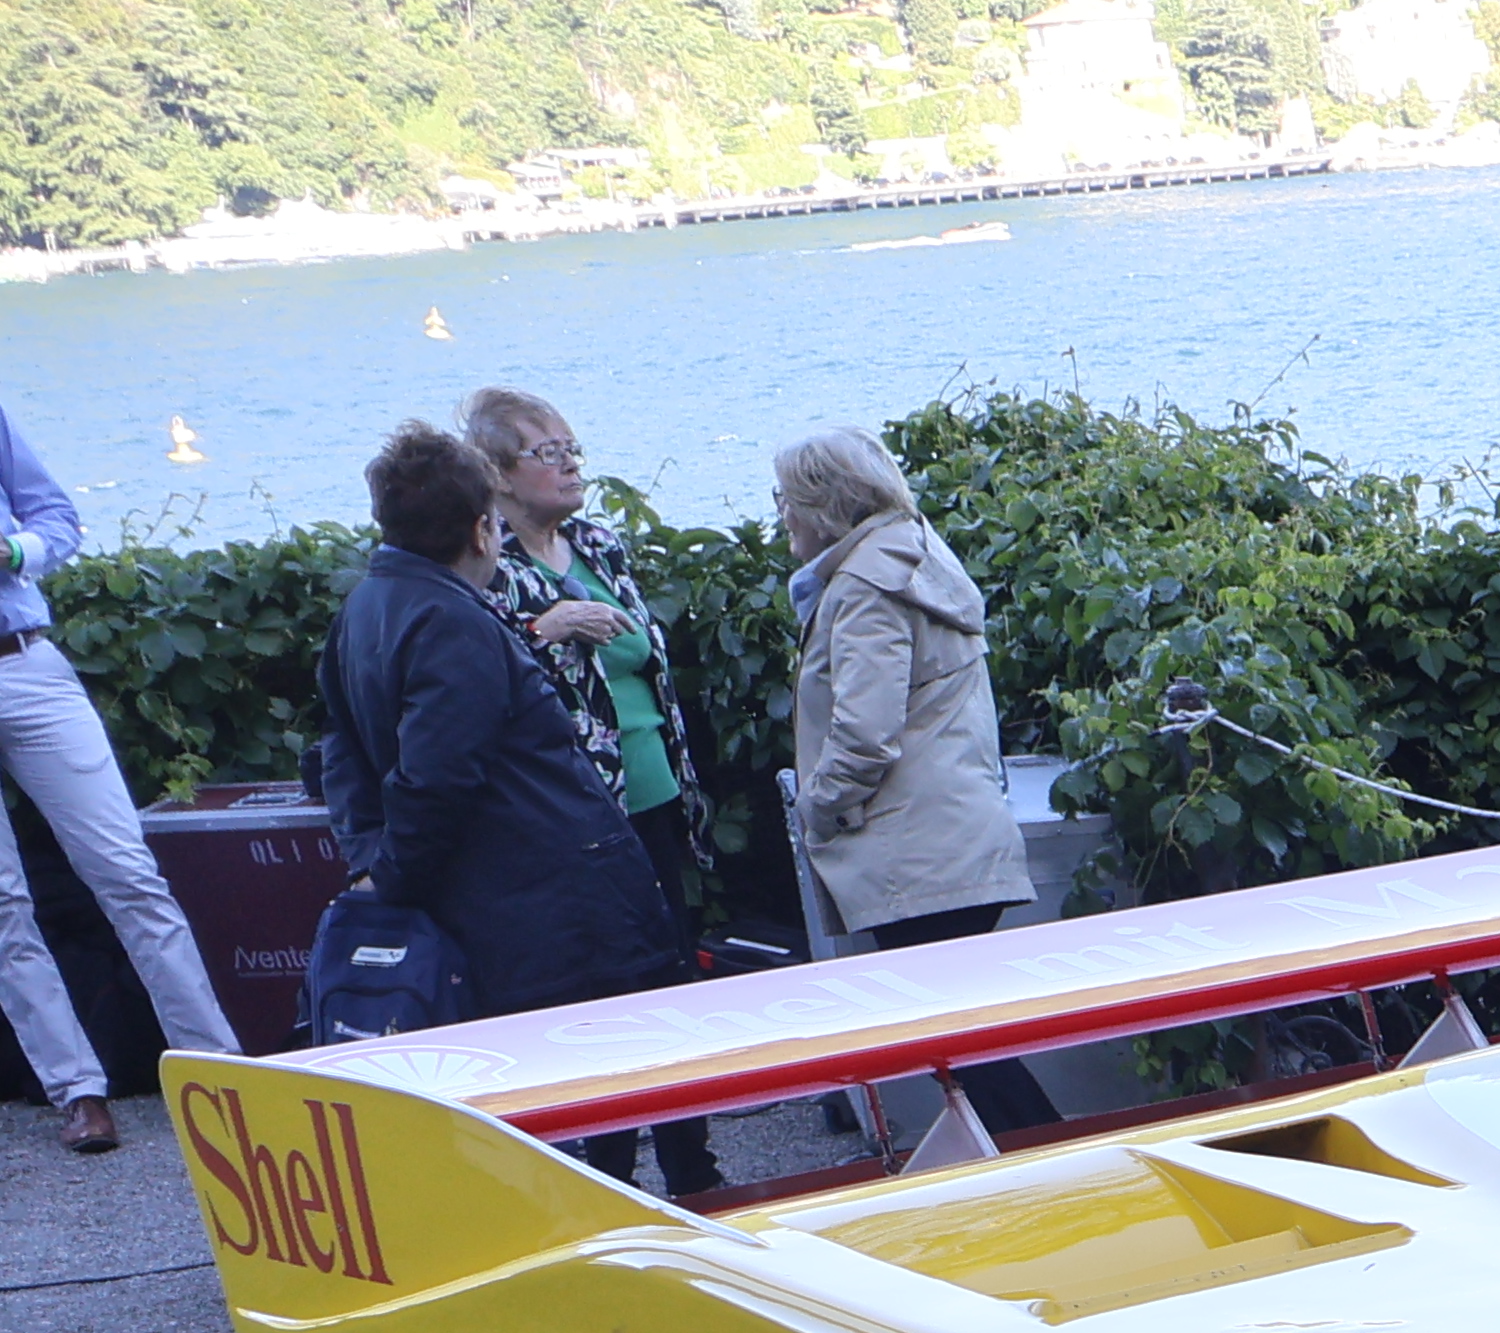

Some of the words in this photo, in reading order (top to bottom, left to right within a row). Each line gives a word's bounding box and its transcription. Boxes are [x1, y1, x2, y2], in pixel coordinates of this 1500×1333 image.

[546, 969, 954, 1062] Shell
[1001, 919, 1251, 982] mit
[180, 1081, 394, 1286] Shell
